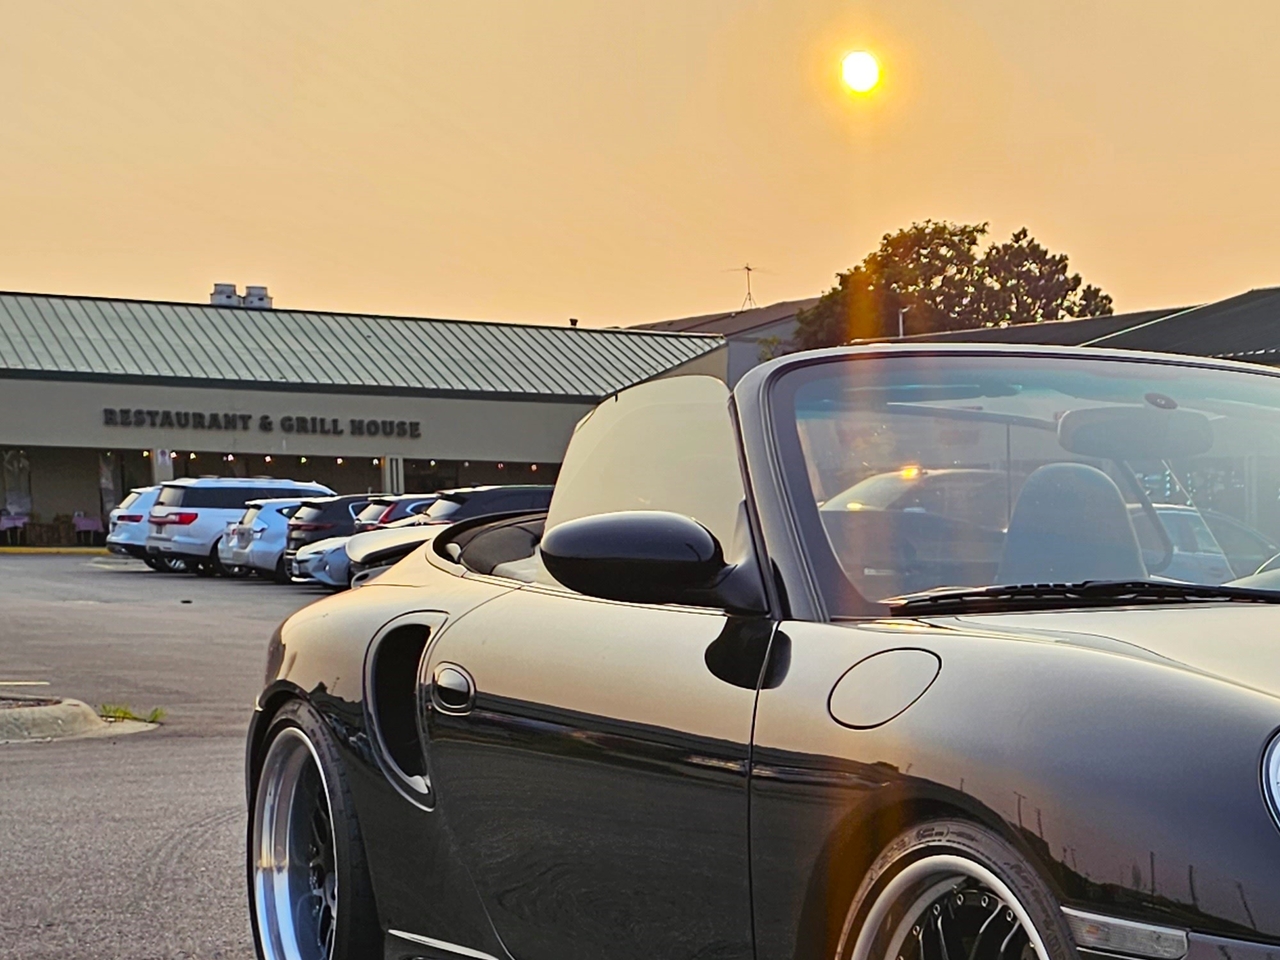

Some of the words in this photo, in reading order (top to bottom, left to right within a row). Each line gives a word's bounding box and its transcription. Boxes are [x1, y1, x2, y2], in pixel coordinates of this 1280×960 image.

[103, 407, 252, 431] RESTAURANT
[259, 414, 274, 433] &
[280, 415, 344, 435] GRILL
[350, 418, 422, 439] HOUSE
